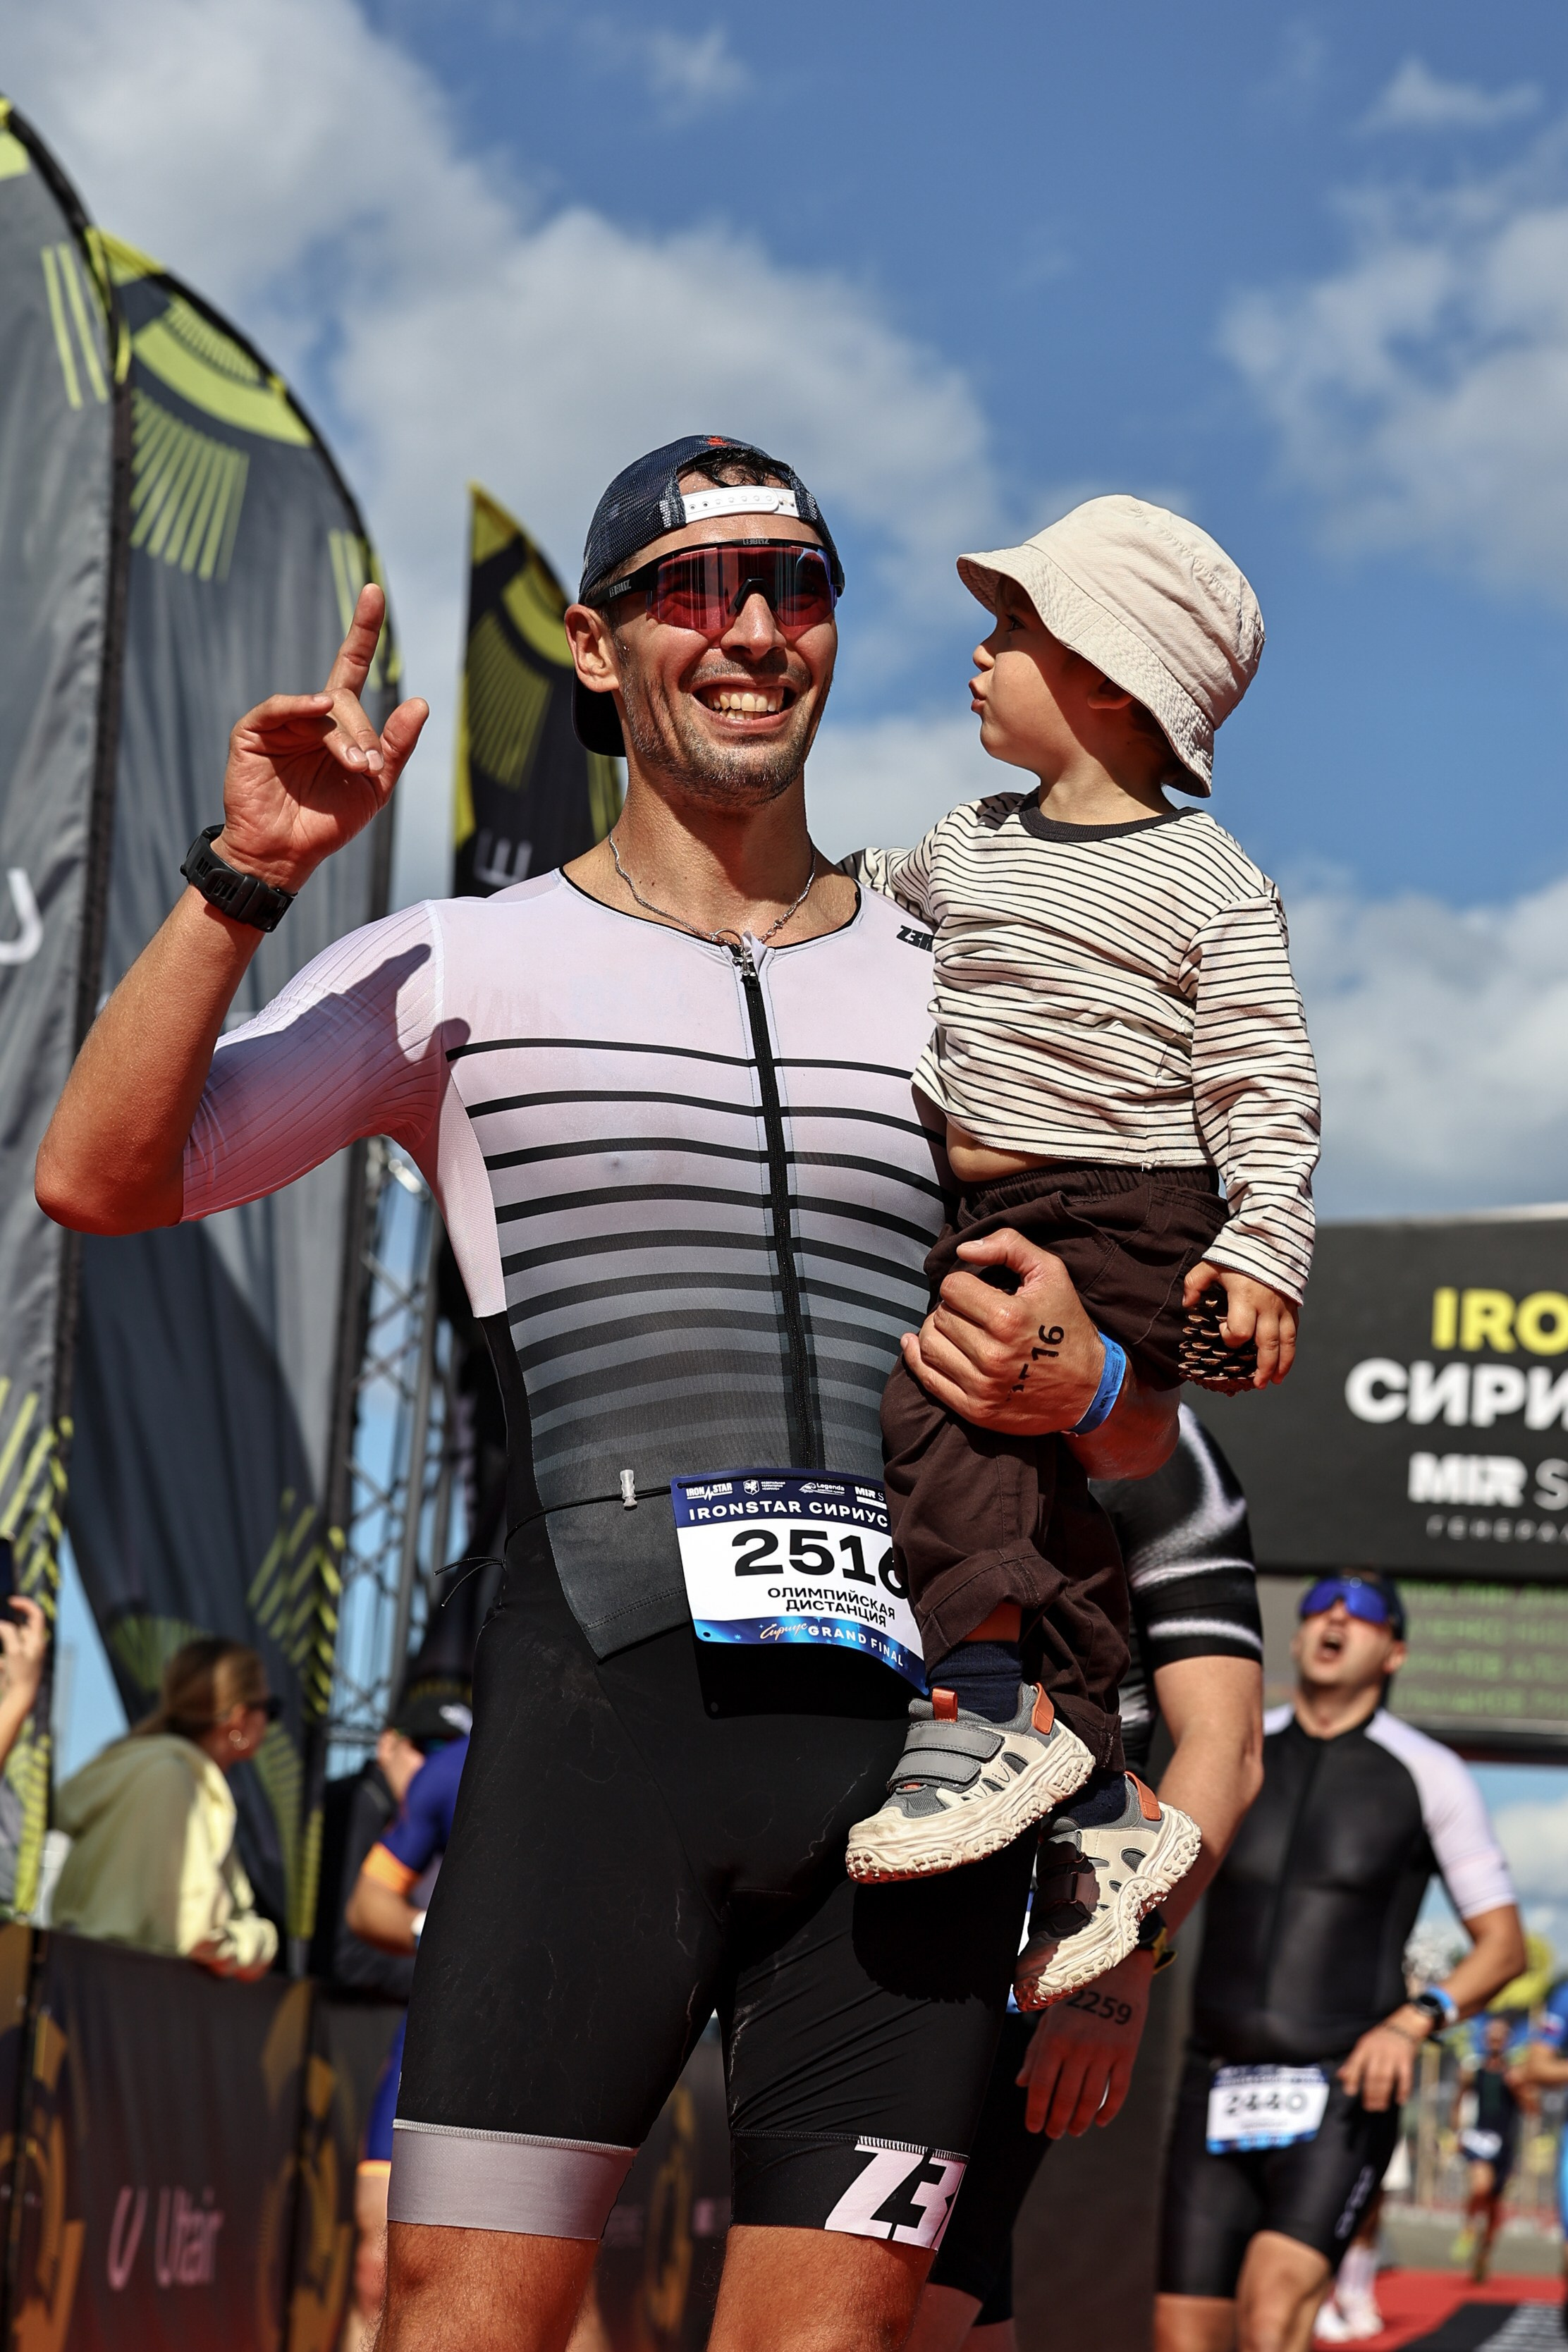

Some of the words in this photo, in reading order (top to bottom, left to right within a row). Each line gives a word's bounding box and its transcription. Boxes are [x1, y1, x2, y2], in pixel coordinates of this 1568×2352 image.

[1431, 1286, 1568, 1356] IRO
[1345, 1356, 1568, 1431] СИРИ
[816, 1482, 845, 1491] Legenda
[855, 1486, 876, 1498] MIR
[1408, 1451, 1528, 1509] MIR
[689, 1500, 802, 1521] IRONSTAR
[809, 1501, 888, 1528] СИРИУС
[732, 1529, 910, 1600] 2516
[768, 1587, 895, 1620] ОЛИМПИЙСКАЯ
[786, 1599, 886, 1627] ДИСТАНЦИЯ
[759, 1622, 808, 1641] Сириус
[808, 1626, 866, 1644] GRAND
[871, 1638, 904, 1667] FINAL
[1067, 1990, 1132, 2025] 2259
[824, 2143, 967, 2250] Z3
